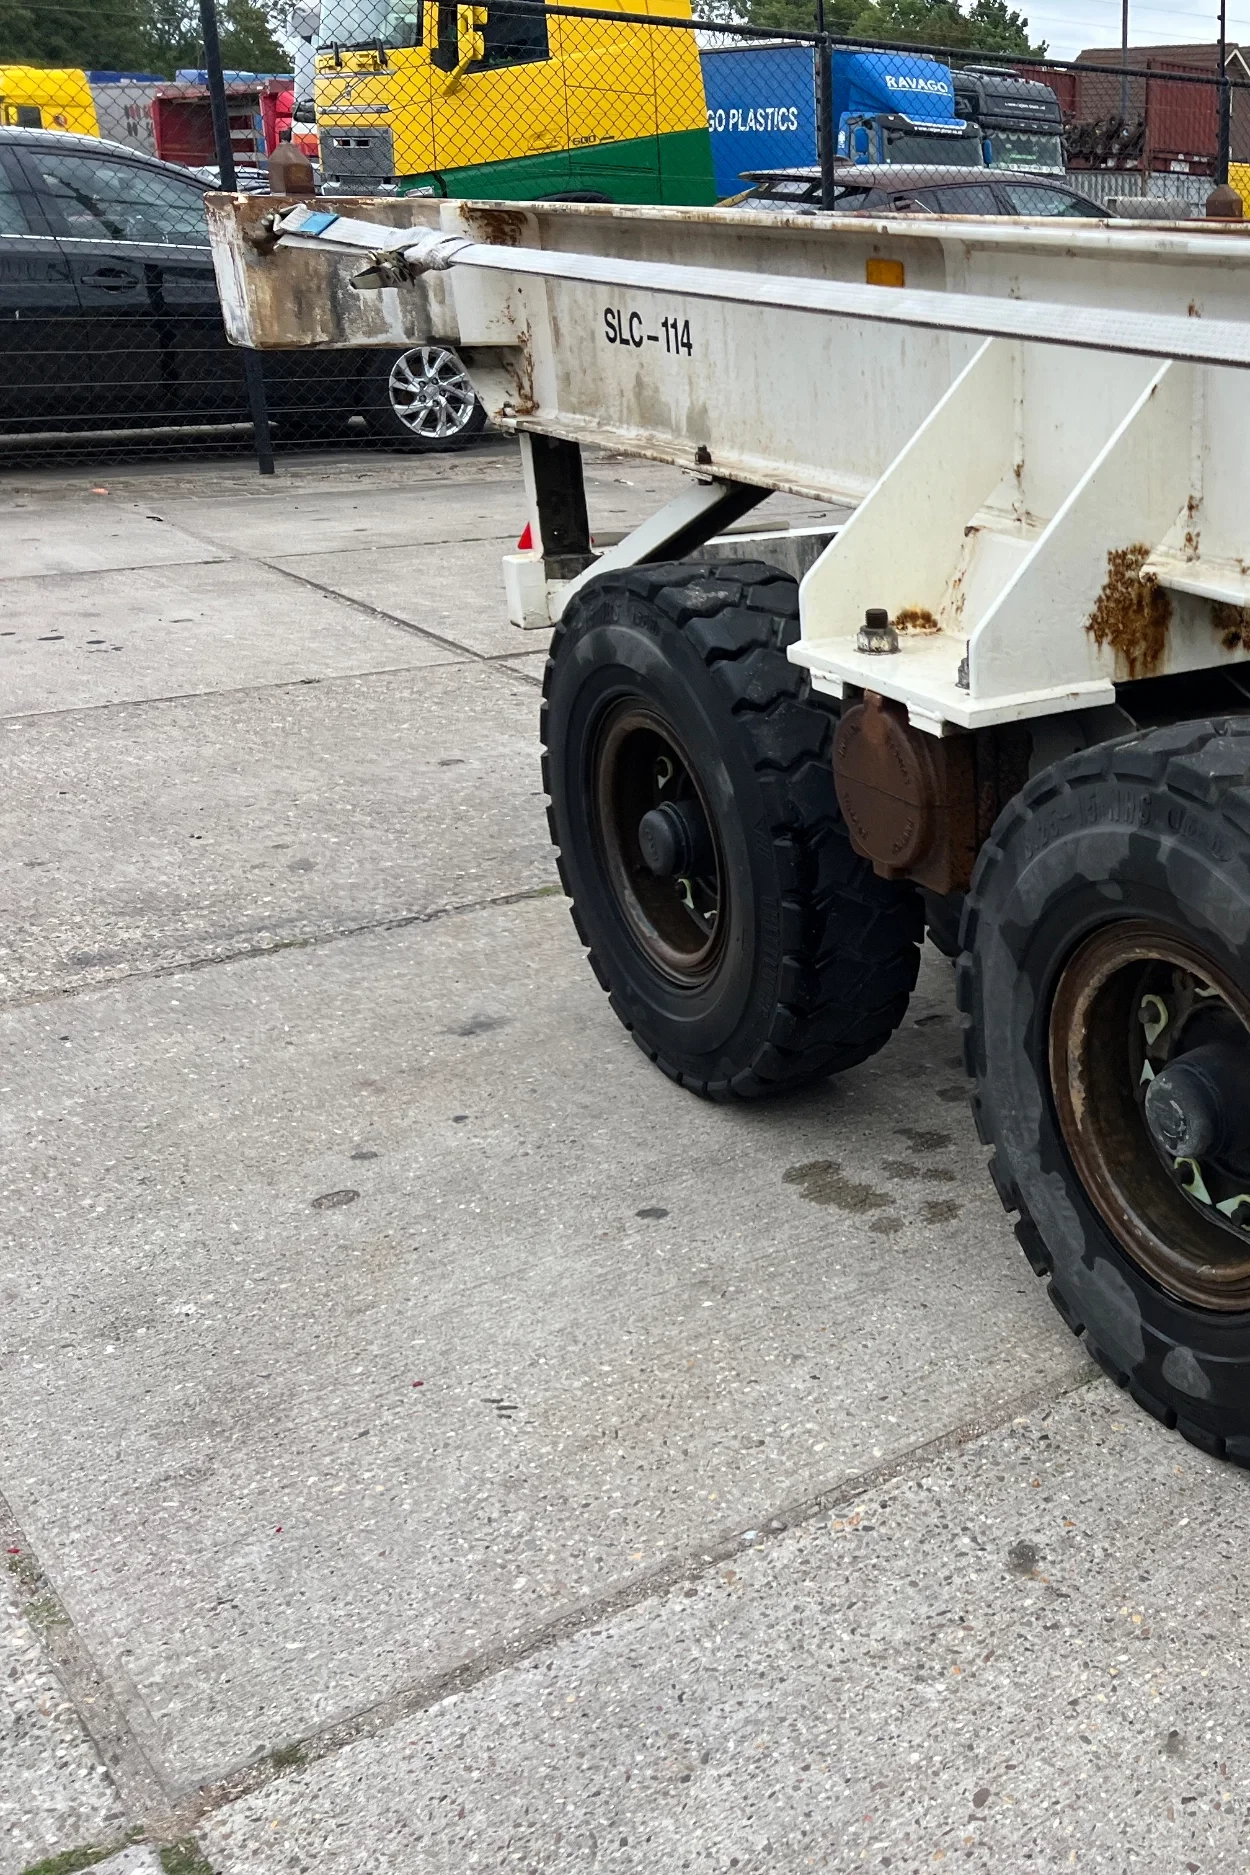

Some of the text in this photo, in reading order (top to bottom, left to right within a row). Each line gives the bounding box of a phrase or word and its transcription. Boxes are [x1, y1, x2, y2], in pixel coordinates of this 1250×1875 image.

[885, 75, 948, 93] RAVAGO
[706, 107, 798, 133] GO PLASTICS
[603, 307, 693, 357] SLC-114
